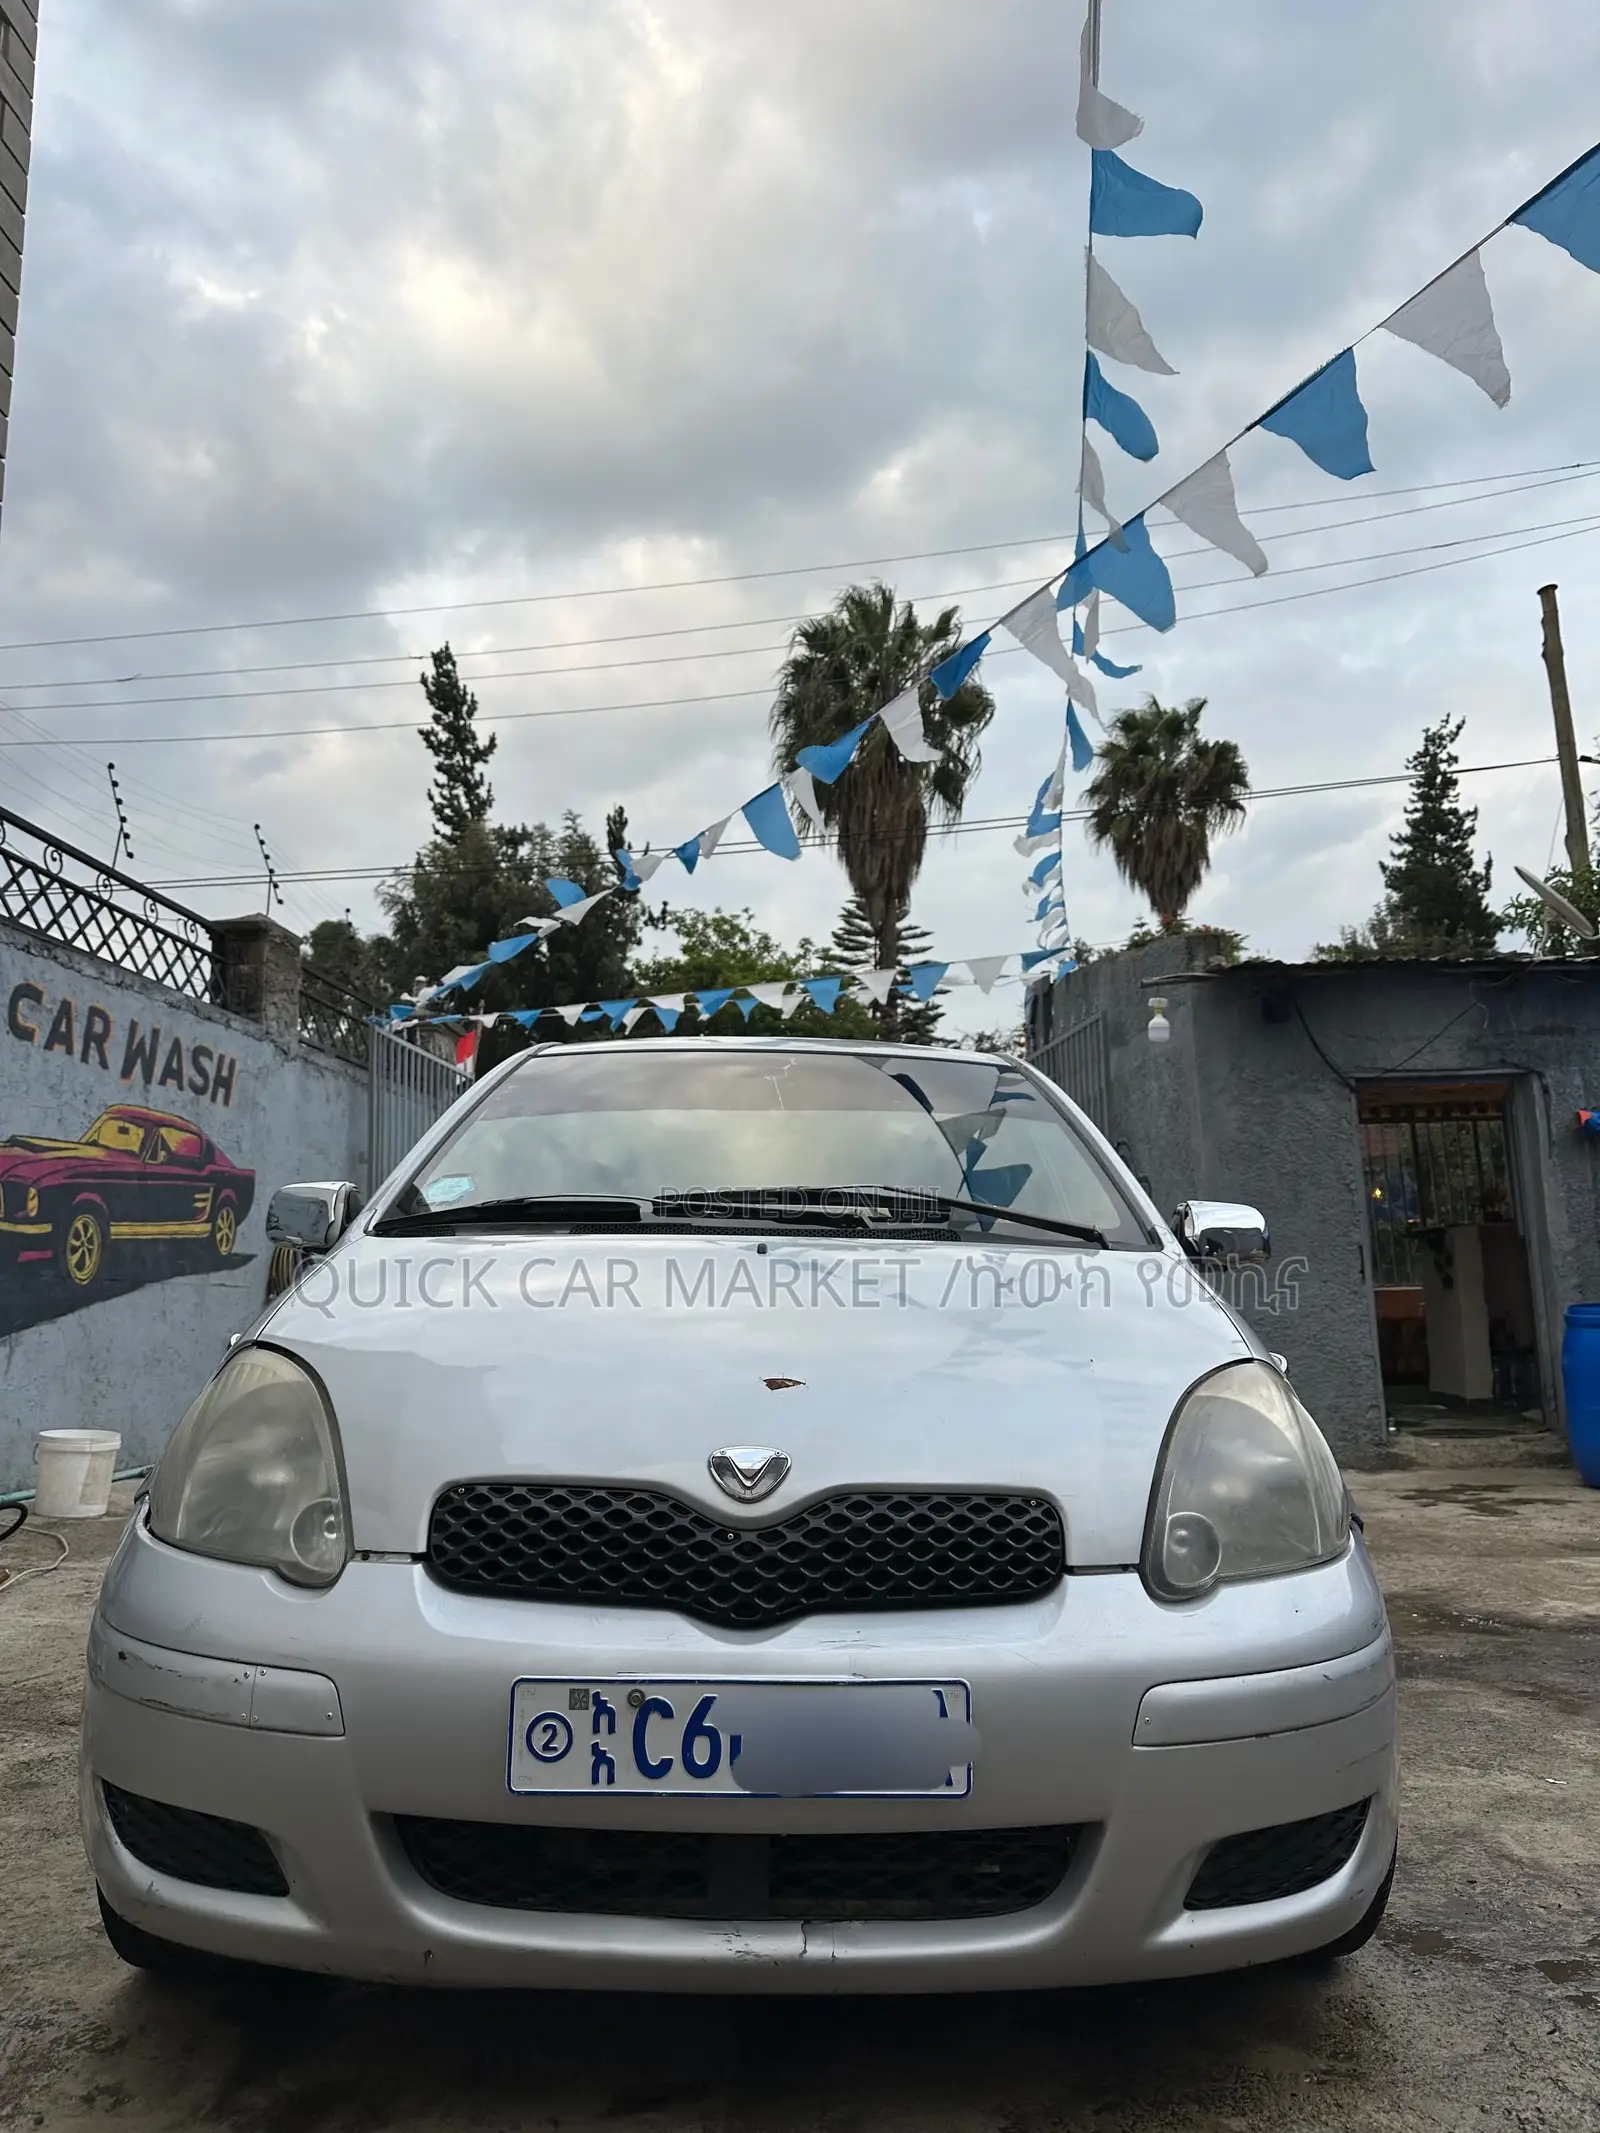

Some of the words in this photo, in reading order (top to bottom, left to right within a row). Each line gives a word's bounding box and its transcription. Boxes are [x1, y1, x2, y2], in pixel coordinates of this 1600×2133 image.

[7, 981, 114, 1070] CAR
[120, 1017, 238, 1108] WASH
[542, 1723, 558, 1751] 2
